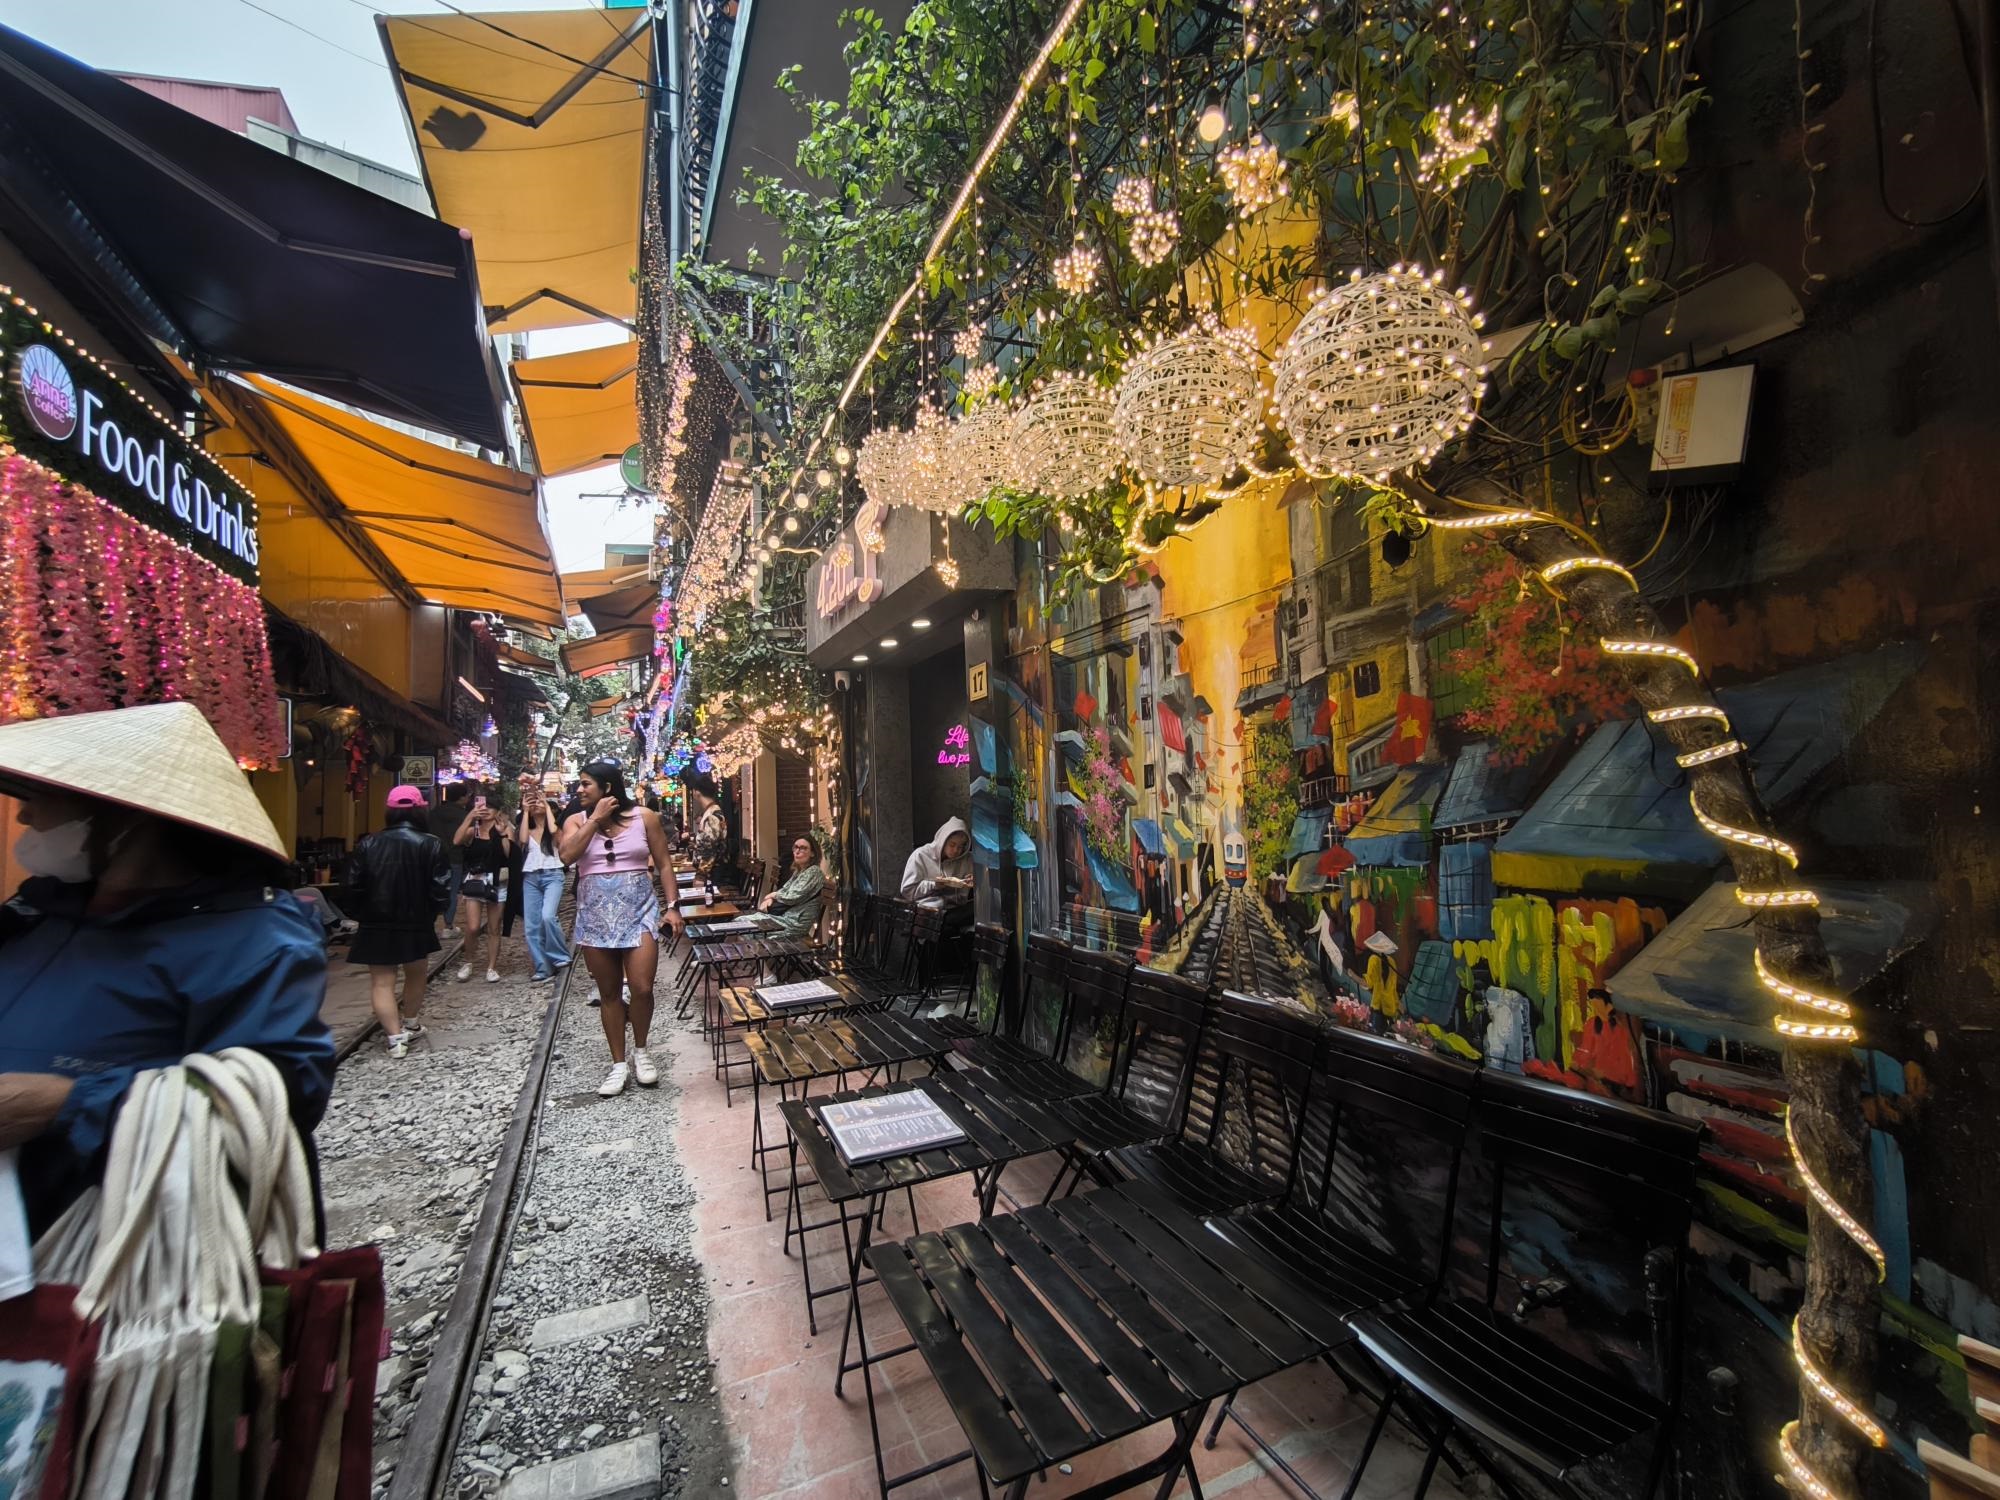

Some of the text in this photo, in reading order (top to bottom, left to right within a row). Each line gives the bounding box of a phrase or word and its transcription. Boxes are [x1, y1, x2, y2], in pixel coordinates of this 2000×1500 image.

[31, 371, 69, 412] Anna
[83, 390, 258, 566] Food & Drinks
[972, 670, 984, 693] 17
[944, 724, 969, 749] Life
